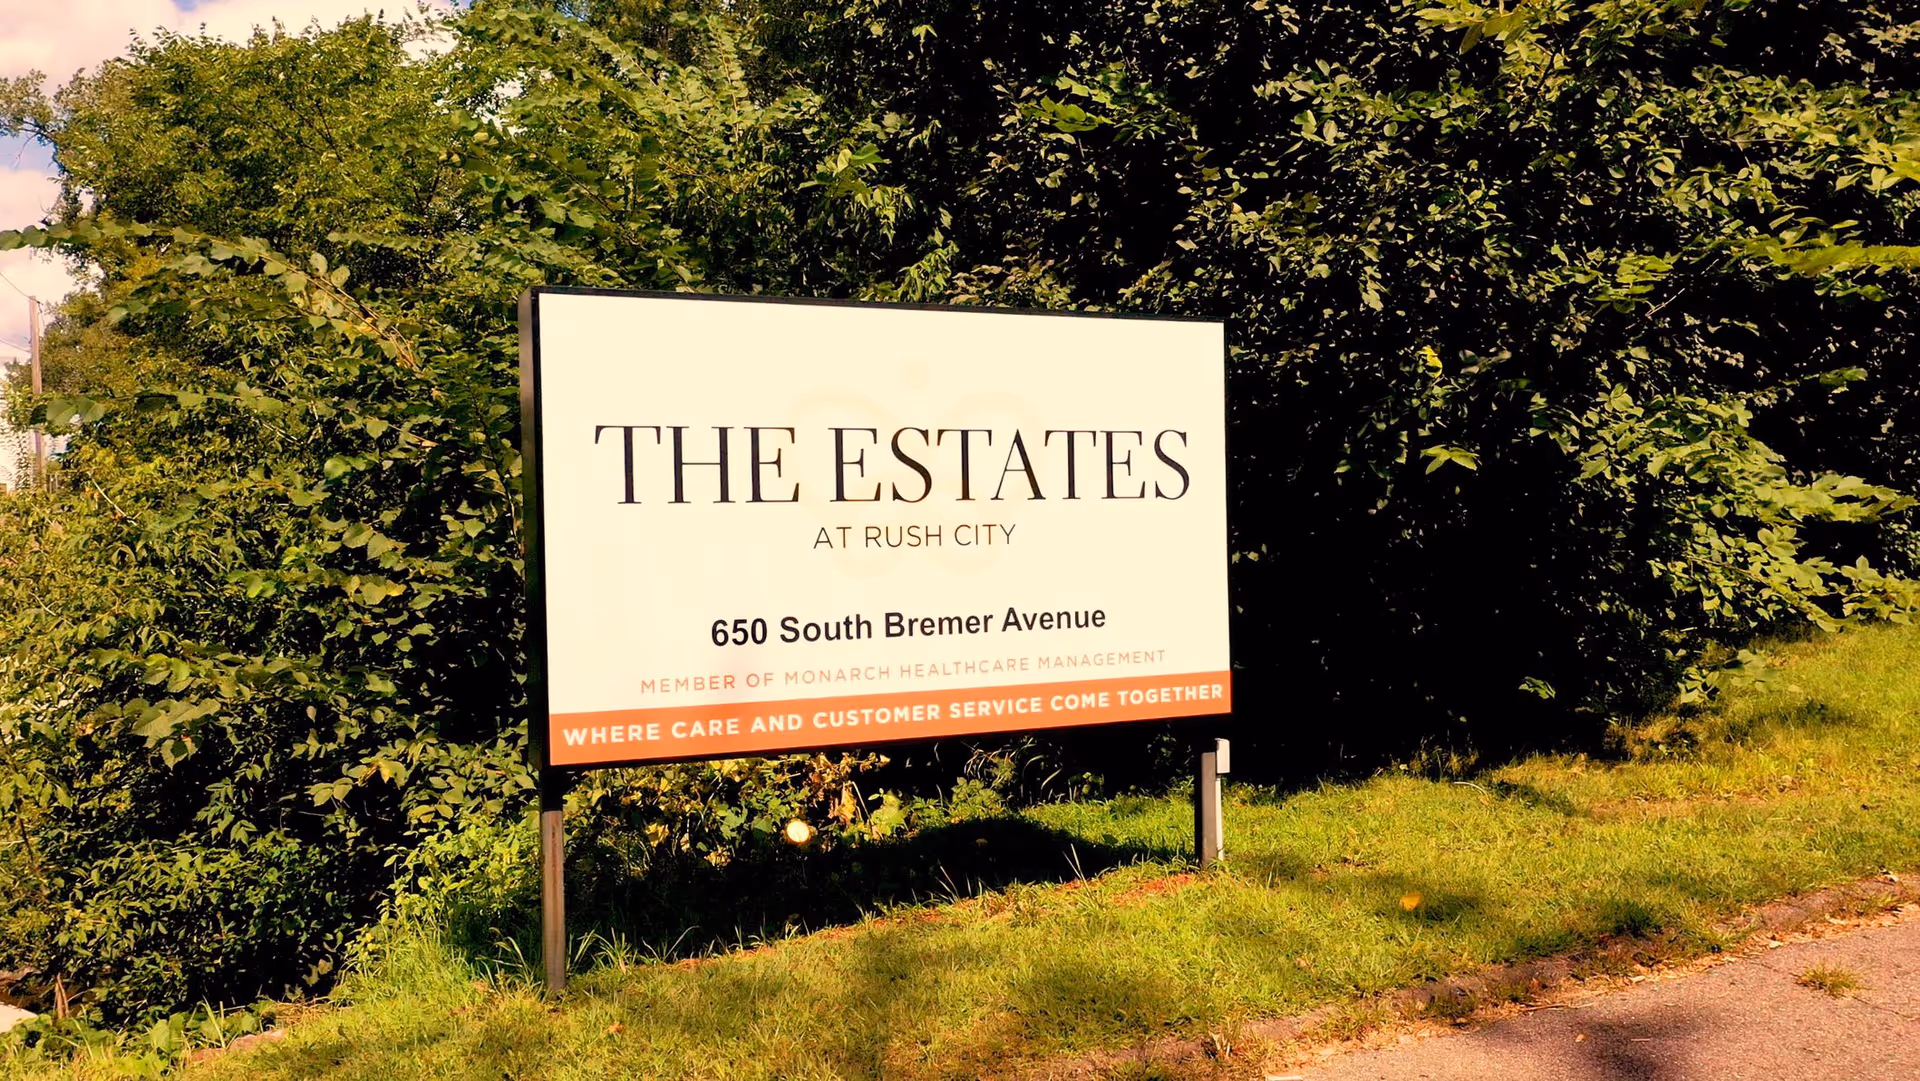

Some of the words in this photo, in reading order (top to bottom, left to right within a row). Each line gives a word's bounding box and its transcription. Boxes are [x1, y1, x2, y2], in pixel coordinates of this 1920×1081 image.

[595, 425, 799, 504] THE
[828, 427, 1189, 503] ESTATES
[813, 526, 852, 549] AT
[865, 525, 941, 548] RUSH
[954, 524, 1016, 546] CITY
[712, 618, 767, 646] 650
[780, 614, 872, 643] South
[885, 612, 993, 638] Bremer
[1001, 607, 1105, 632] Avenue
[641, 674, 735, 694] MEMBER
[746, 673, 773, 688] OF
[785, 667, 889, 685] MONARCH
[900, 658, 1028, 678] HEALTHCARE
[1039, 650, 1165, 669] MANAGEMENT
[563, 723, 659, 745] WHERE
[672, 719, 739, 738] CARE
[751, 714, 802, 732] AND
[813, 704, 939, 728] CUSTOMER
[950, 697, 1041, 718] SERVICE
[1051, 692, 1109, 710] COME
[1118, 684, 1222, 705] TOGETHER
